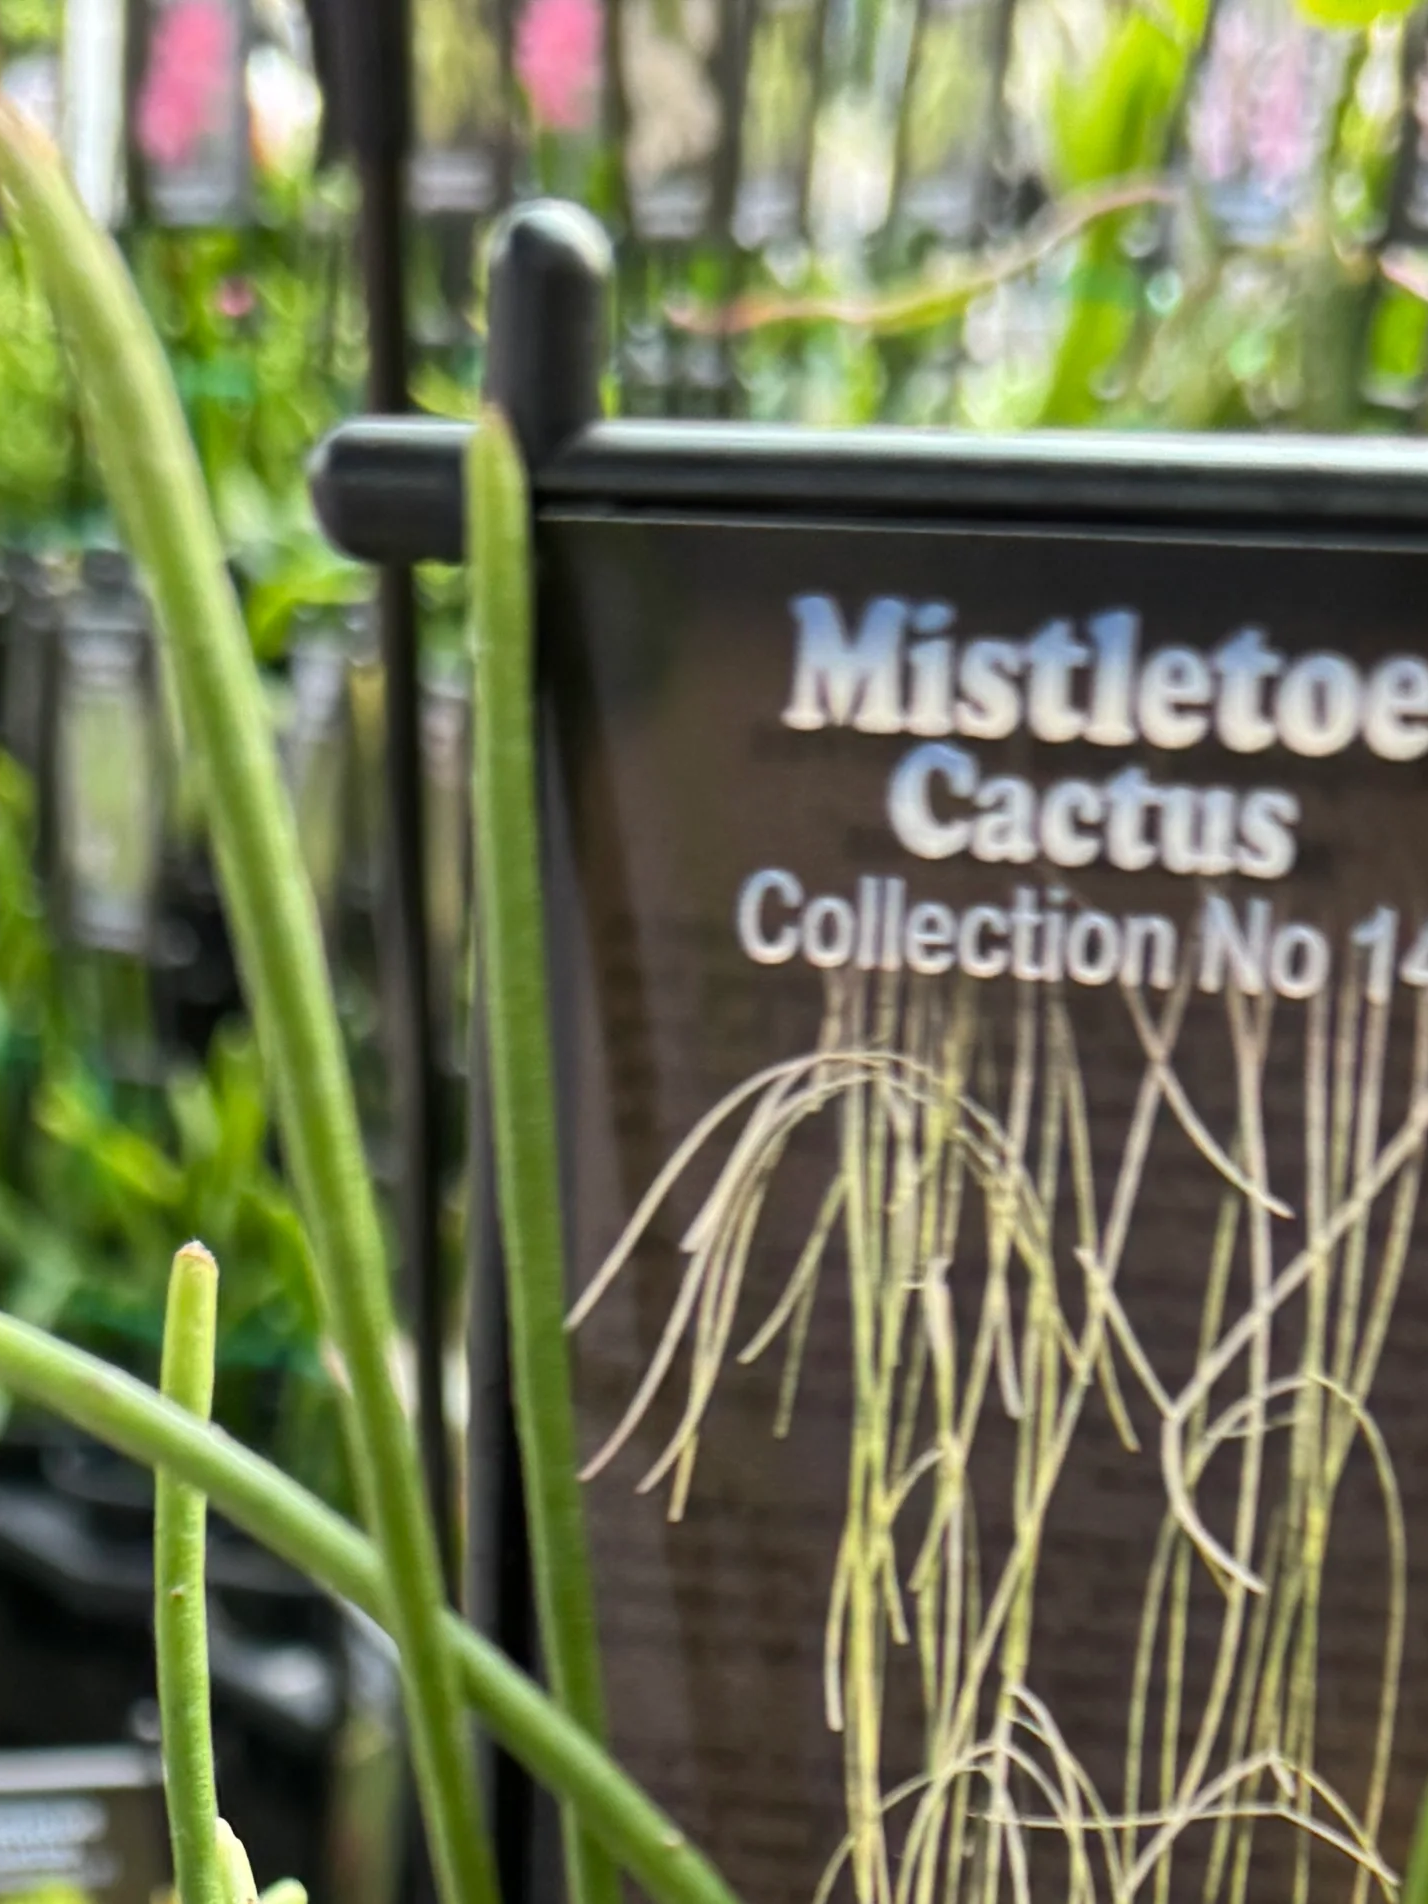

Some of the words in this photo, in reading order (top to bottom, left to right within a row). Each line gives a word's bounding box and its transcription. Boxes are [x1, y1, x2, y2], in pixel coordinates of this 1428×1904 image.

[885, 741, 1303, 880] Cactus
[737, 867, 1176, 990] Collection
[1197, 889, 1332, 1000] No
